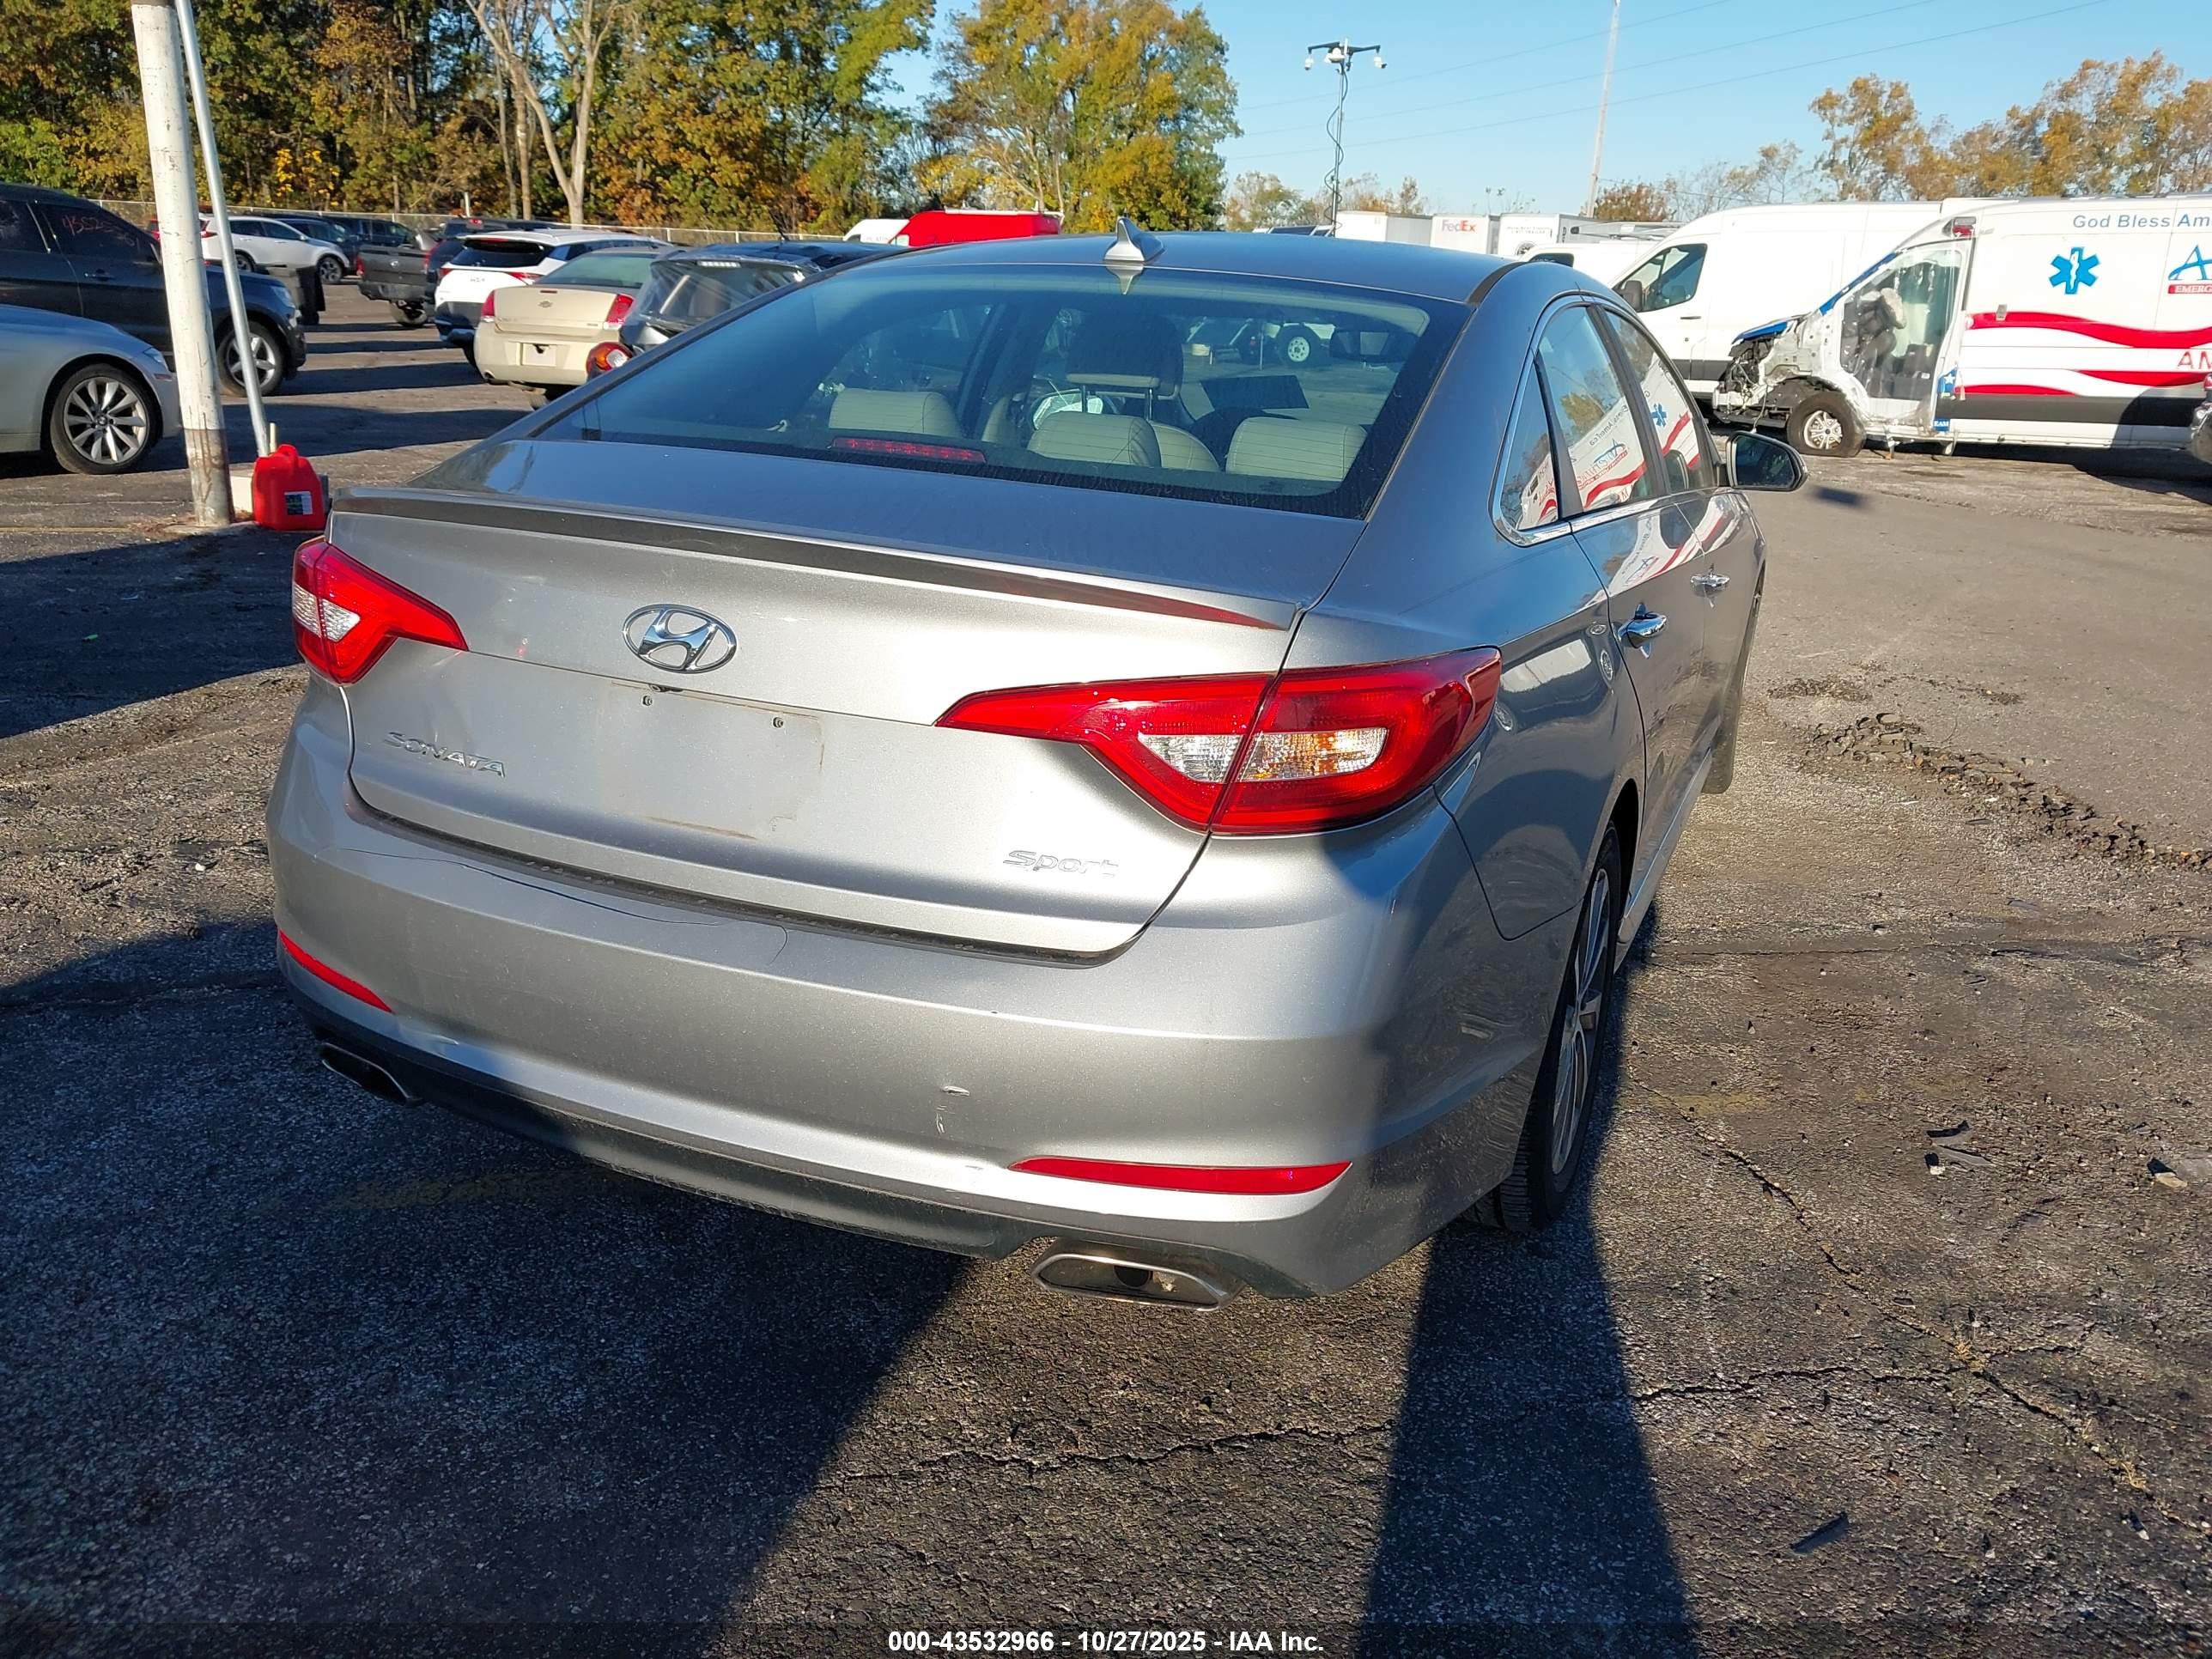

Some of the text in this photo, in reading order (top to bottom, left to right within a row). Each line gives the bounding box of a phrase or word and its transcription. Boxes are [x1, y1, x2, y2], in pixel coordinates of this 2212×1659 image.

[1442, 219, 1476, 233] FedEx
[2073, 214, 2111, 228] God
[2118, 214, 2171, 228] Bless
[385, 732, 506, 777] SONATA
[1003, 849, 1119, 878] Sport
